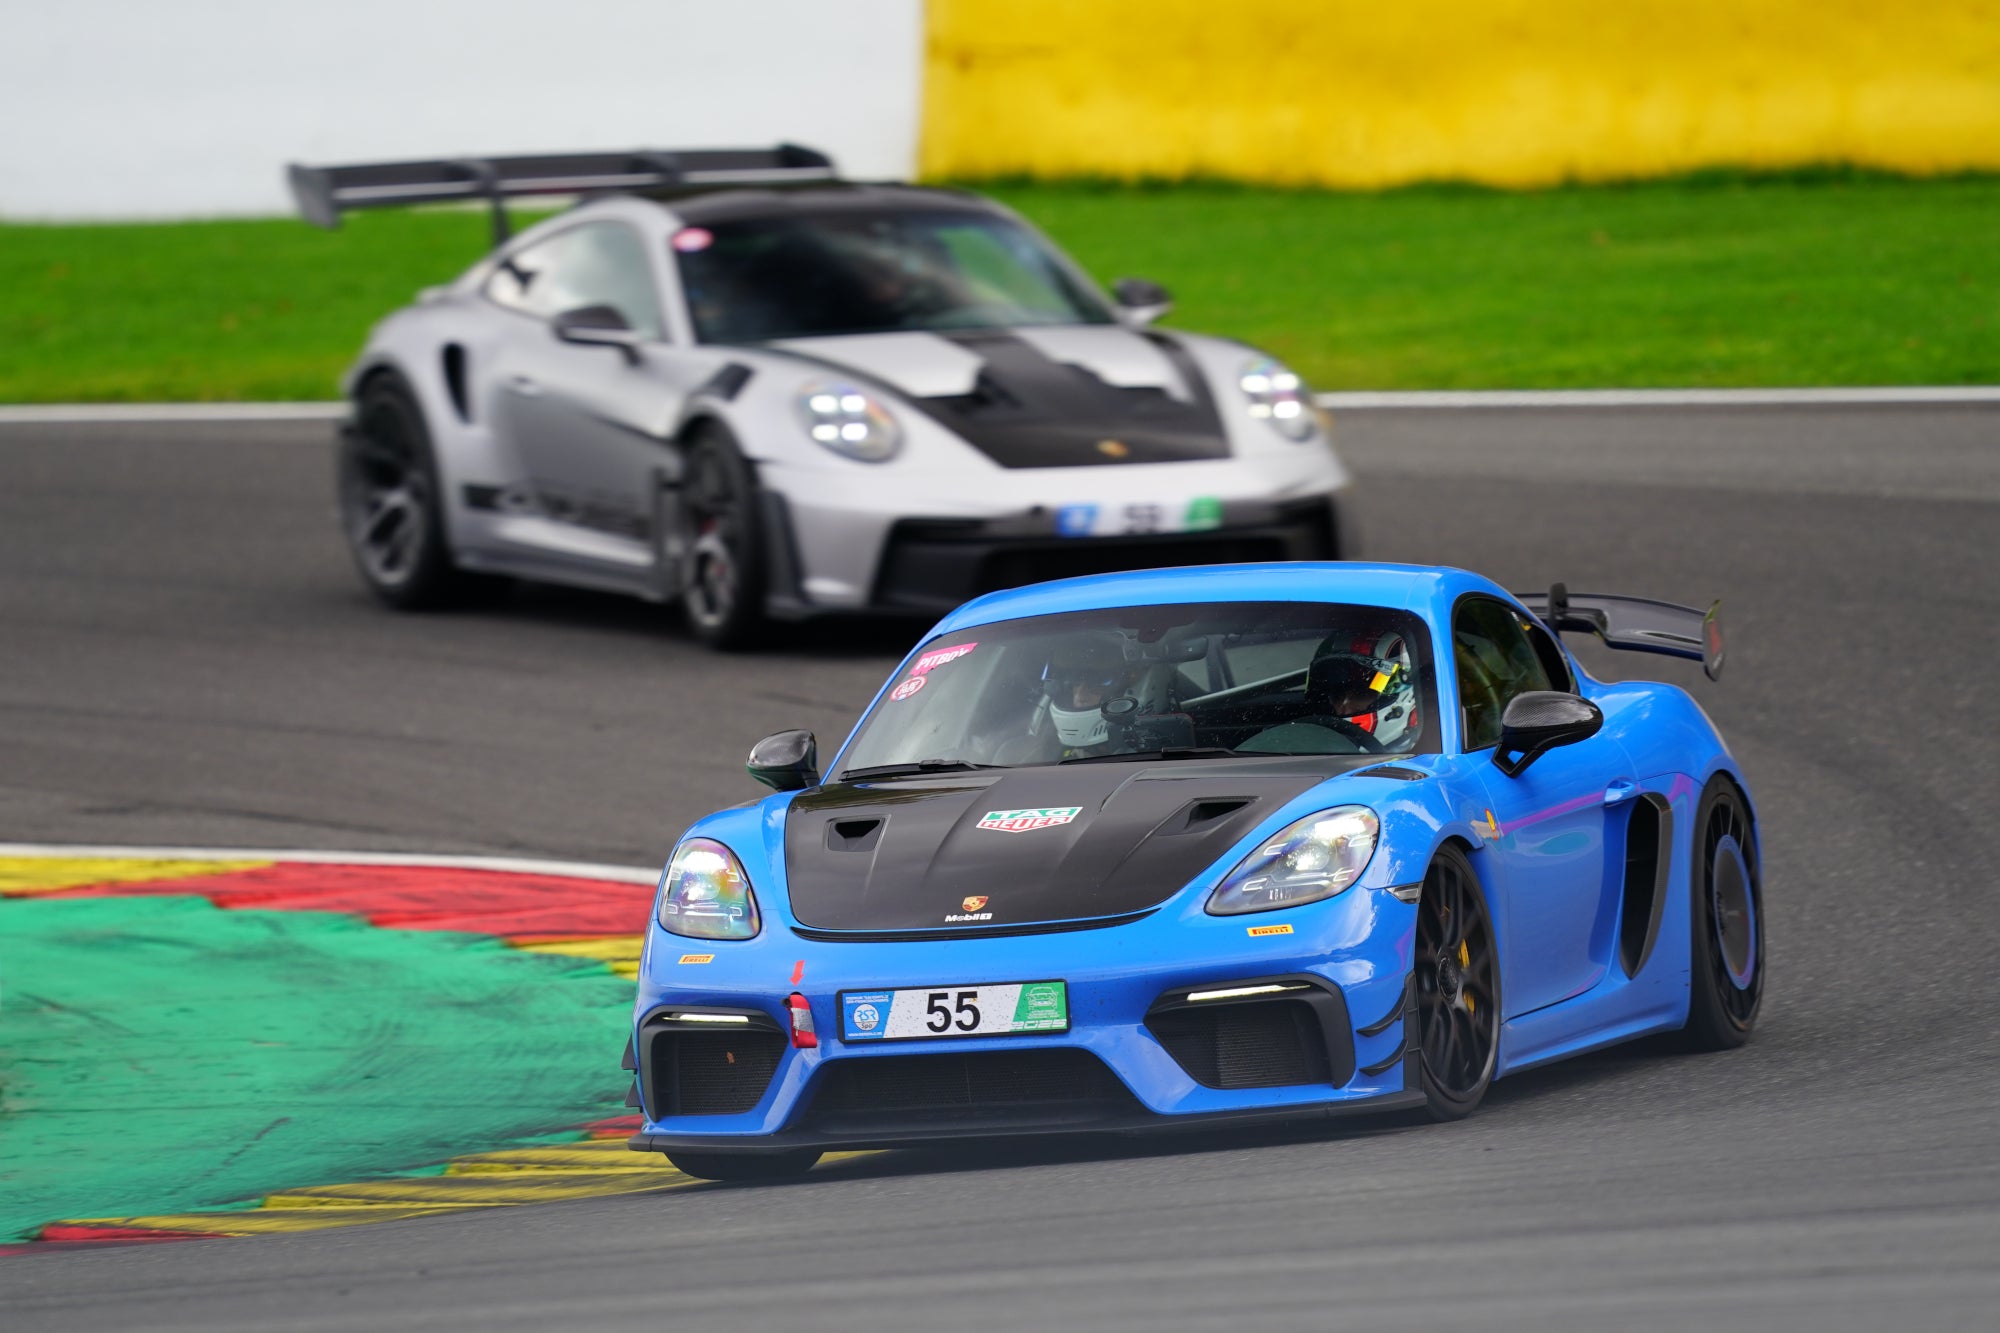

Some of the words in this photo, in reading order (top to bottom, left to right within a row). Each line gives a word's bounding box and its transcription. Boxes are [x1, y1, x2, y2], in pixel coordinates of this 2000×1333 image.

[994, 808, 1069, 819] TAG
[983, 817, 1068, 829] HEUER
[945, 914, 980, 922] Mobil
[857, 1010, 876, 1021] RSR
[926, 991, 981, 1032] 55
[1011, 1018, 1067, 1030] 2025
